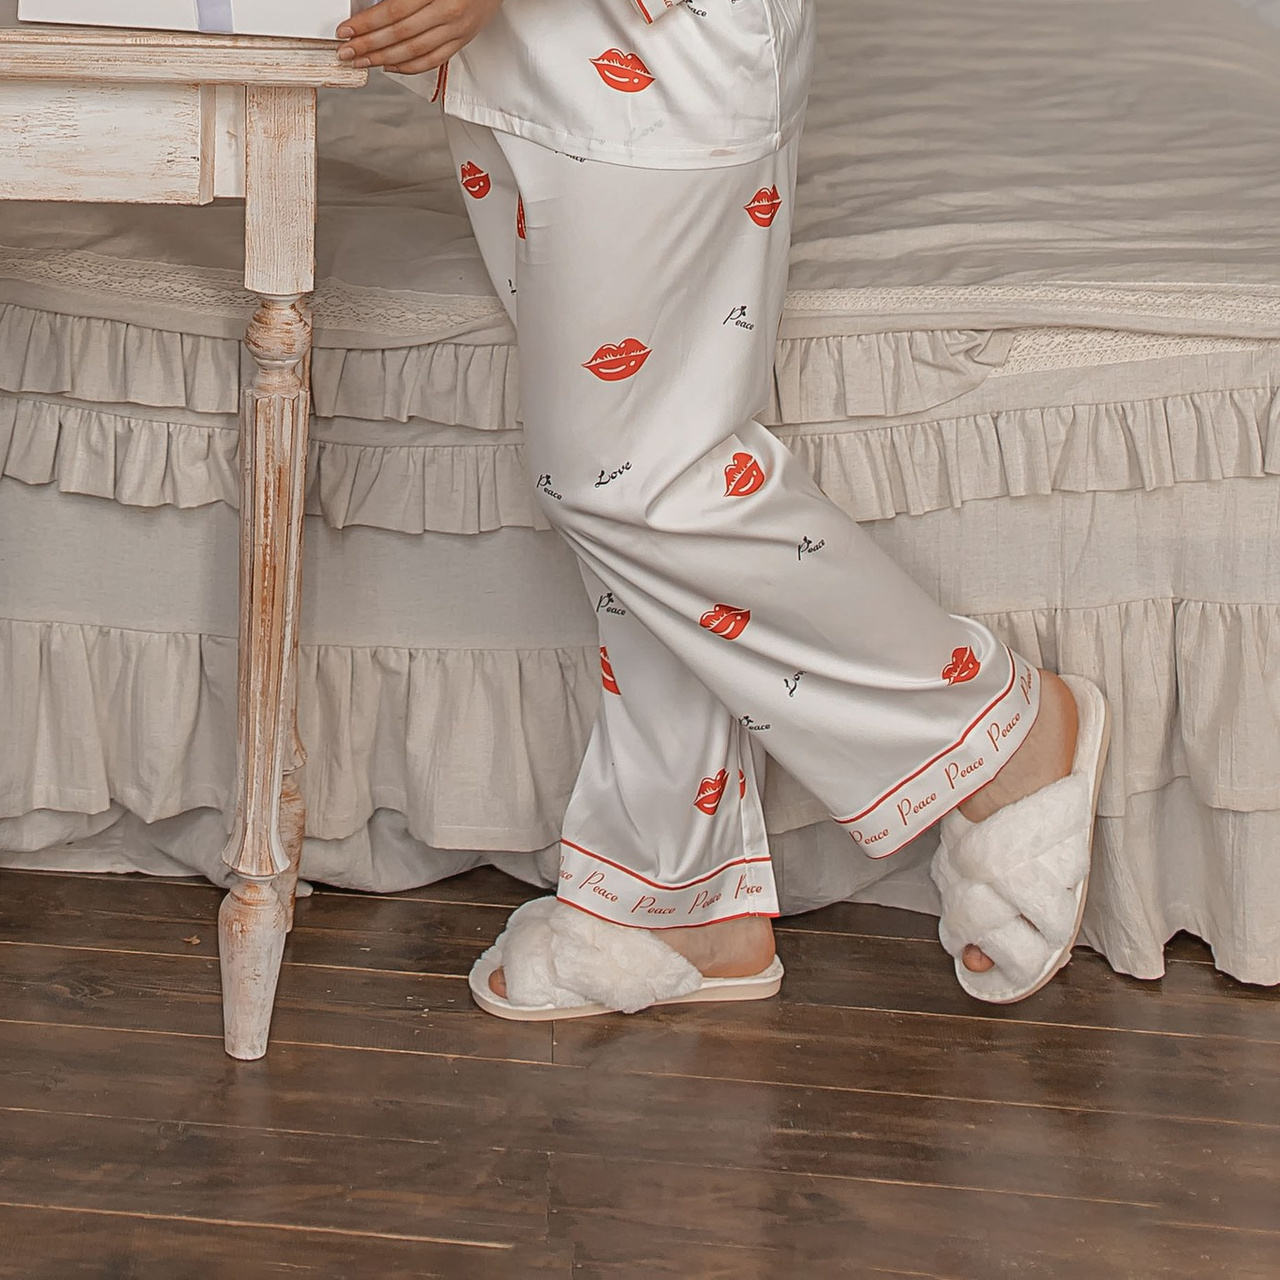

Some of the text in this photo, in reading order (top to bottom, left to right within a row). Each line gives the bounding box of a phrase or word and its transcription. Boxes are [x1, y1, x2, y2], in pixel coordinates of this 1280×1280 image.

[723, 305, 755, 331] Peace
[536, 473, 563, 501] Peace
[594, 460, 633, 488] Love
[596, 592, 627, 616] Peace
[896, 792, 938, 826] Peace
[944, 756, 985, 790] Peace
[986, 712, 1021, 752] Peace
[578, 870, 618, 903] Peace
[630, 894, 676, 914] Peace
[688, 890, 722, 915] Peace
